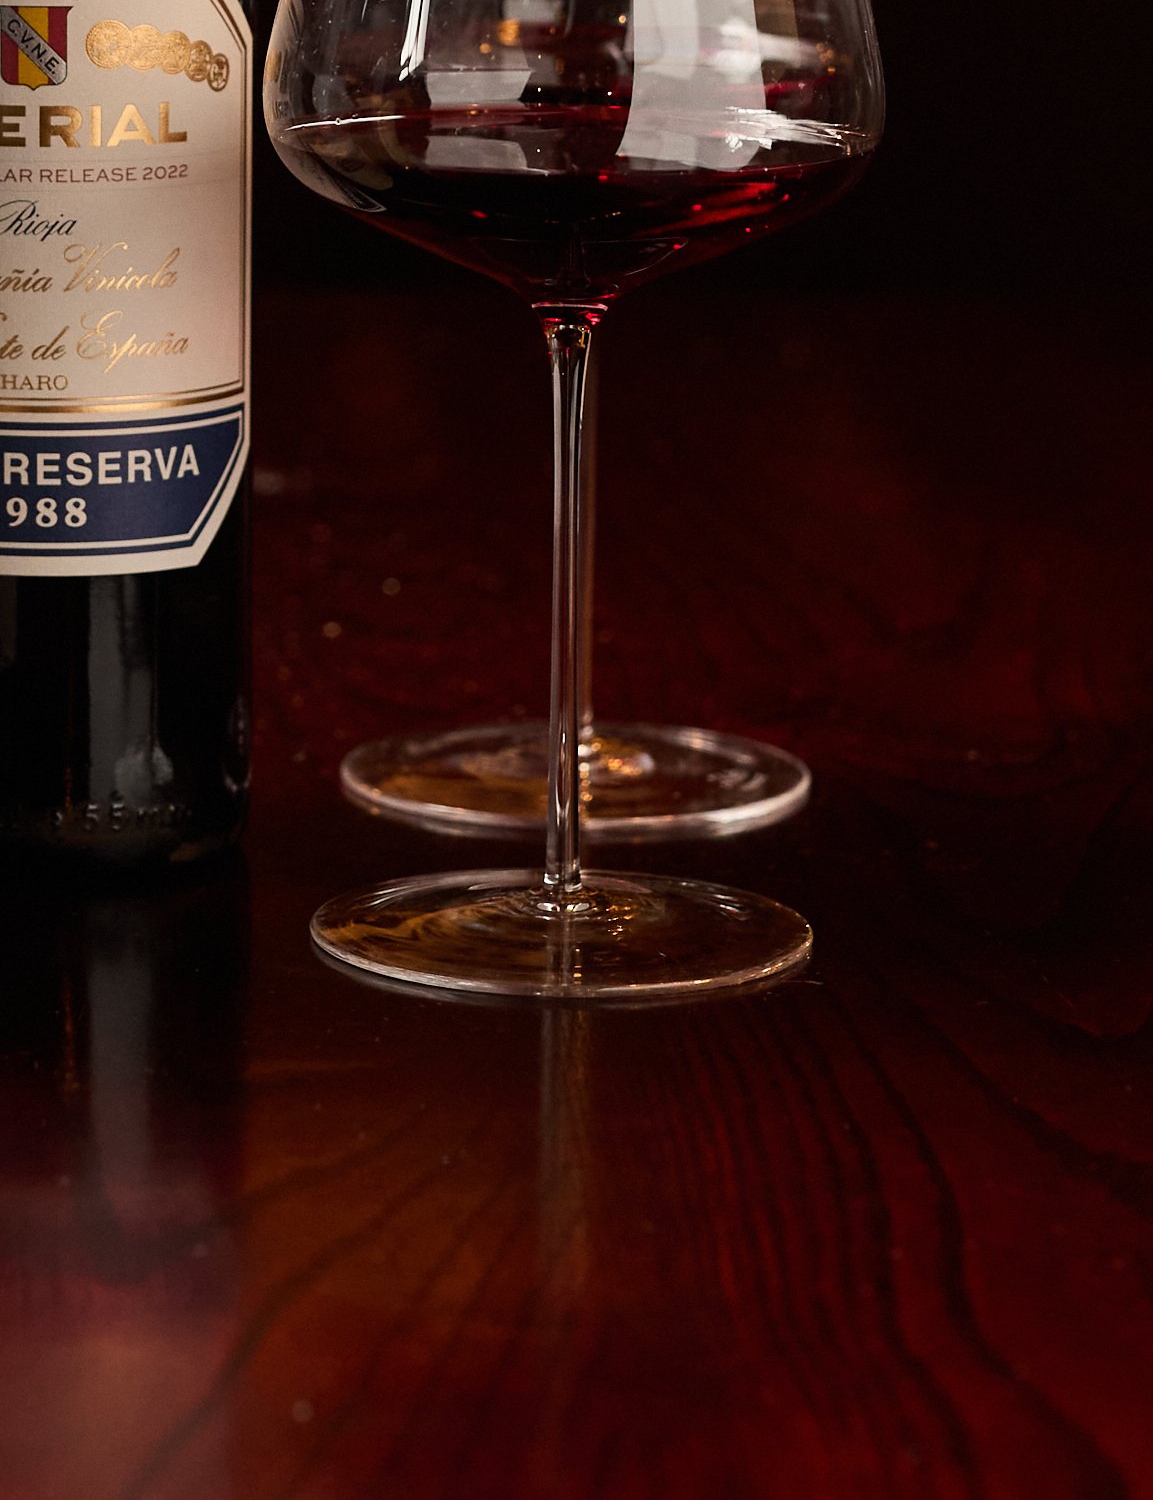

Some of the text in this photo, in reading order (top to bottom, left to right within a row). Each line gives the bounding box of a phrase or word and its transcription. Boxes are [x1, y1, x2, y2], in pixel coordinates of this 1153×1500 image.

[7, 19, 60, 75] C.V.N.E.
[39, 167, 138, 183] RELEASE
[142, 163, 189, 181] 2022
[31, 325, 70, 361] de
[76, 310, 189, 374] España
[0, 373, 69, 392] HARO
[3, 443, 200, 486] RESERVA
